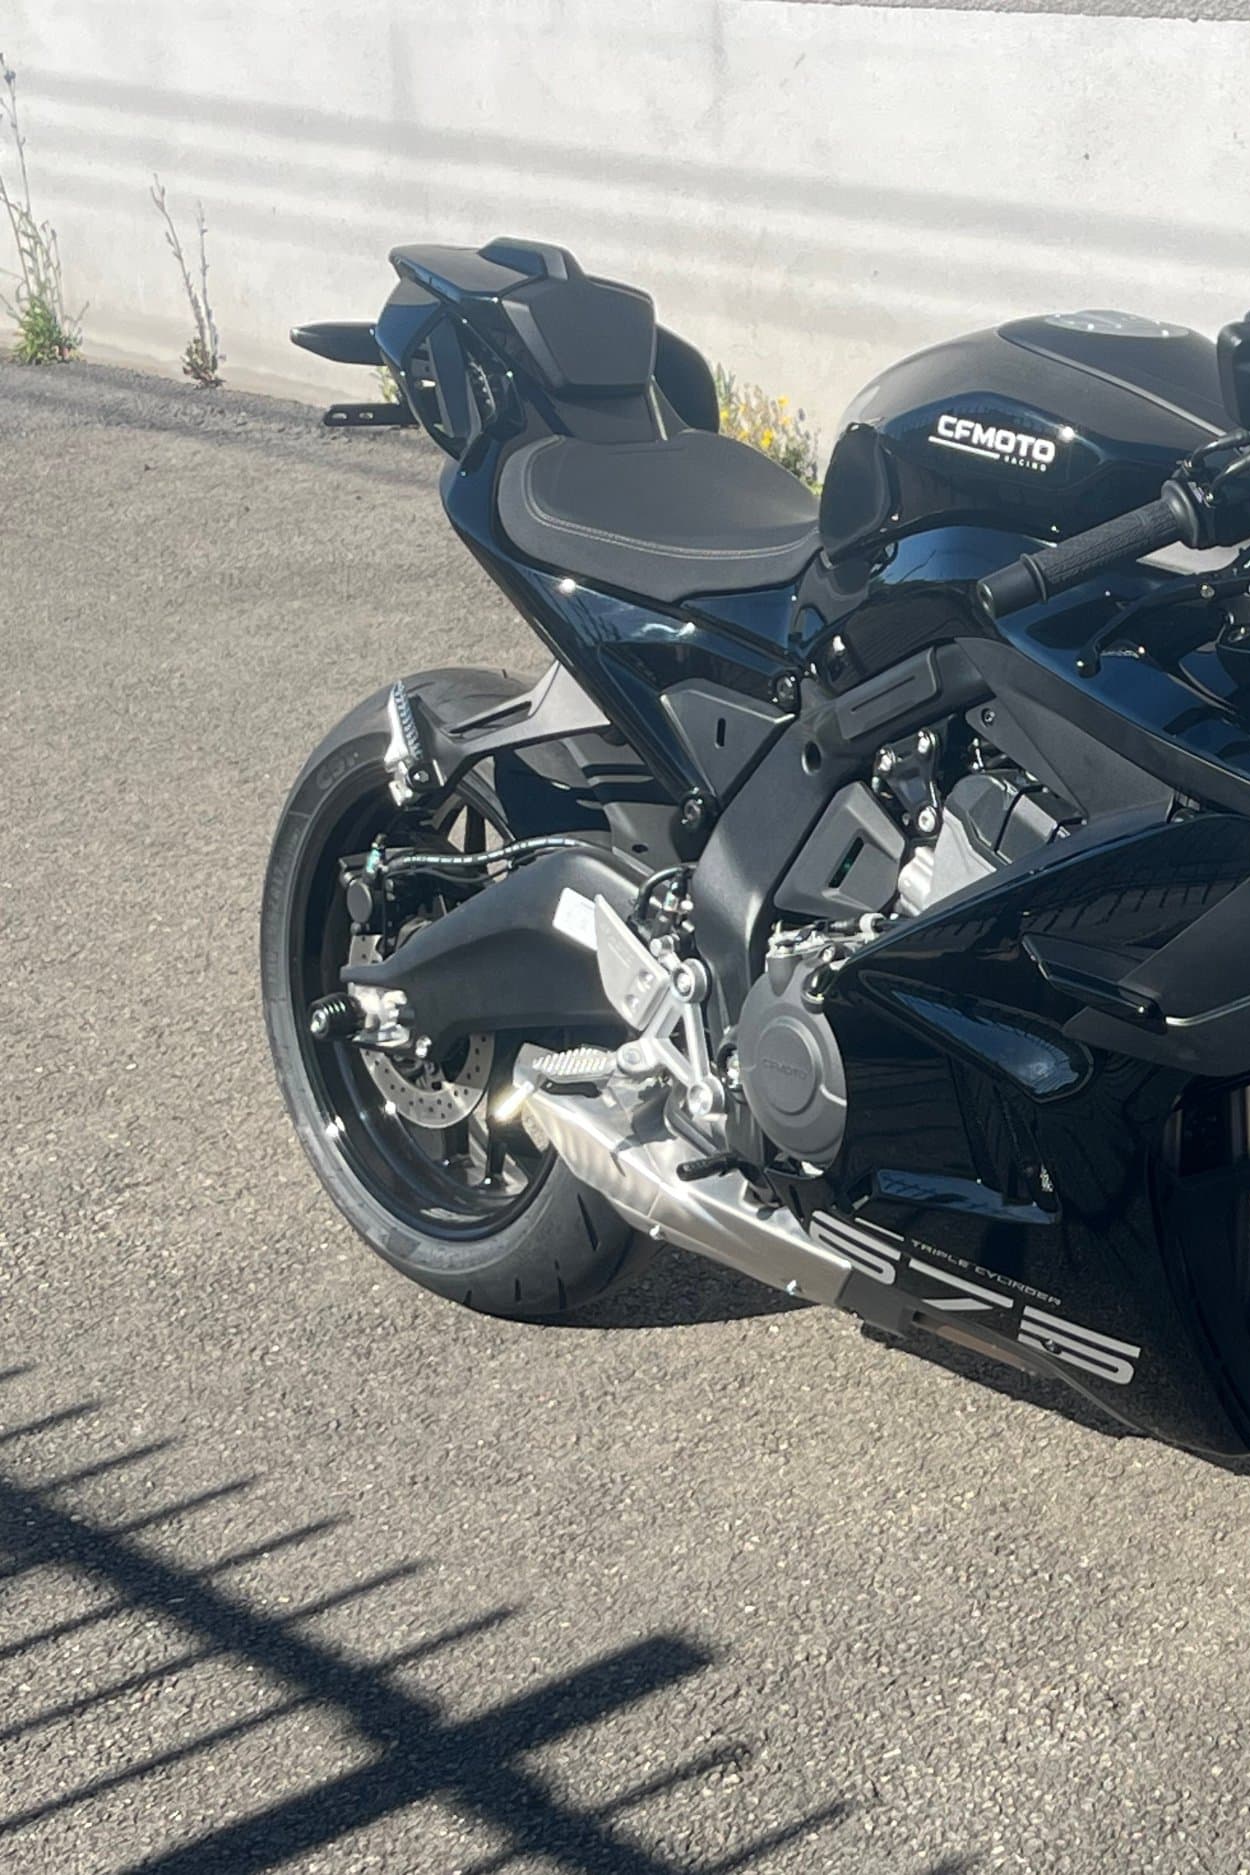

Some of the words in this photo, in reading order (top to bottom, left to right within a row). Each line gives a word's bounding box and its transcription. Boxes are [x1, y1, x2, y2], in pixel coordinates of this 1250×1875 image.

[937, 414, 1056, 464] CFMOTO
[1003, 455, 1047, 473] RACING
[762, 1057, 809, 1081] CFMOTO
[910, 1238, 969, 1269] TRIPLE
[973, 1265, 1062, 1306] CYLINDER
